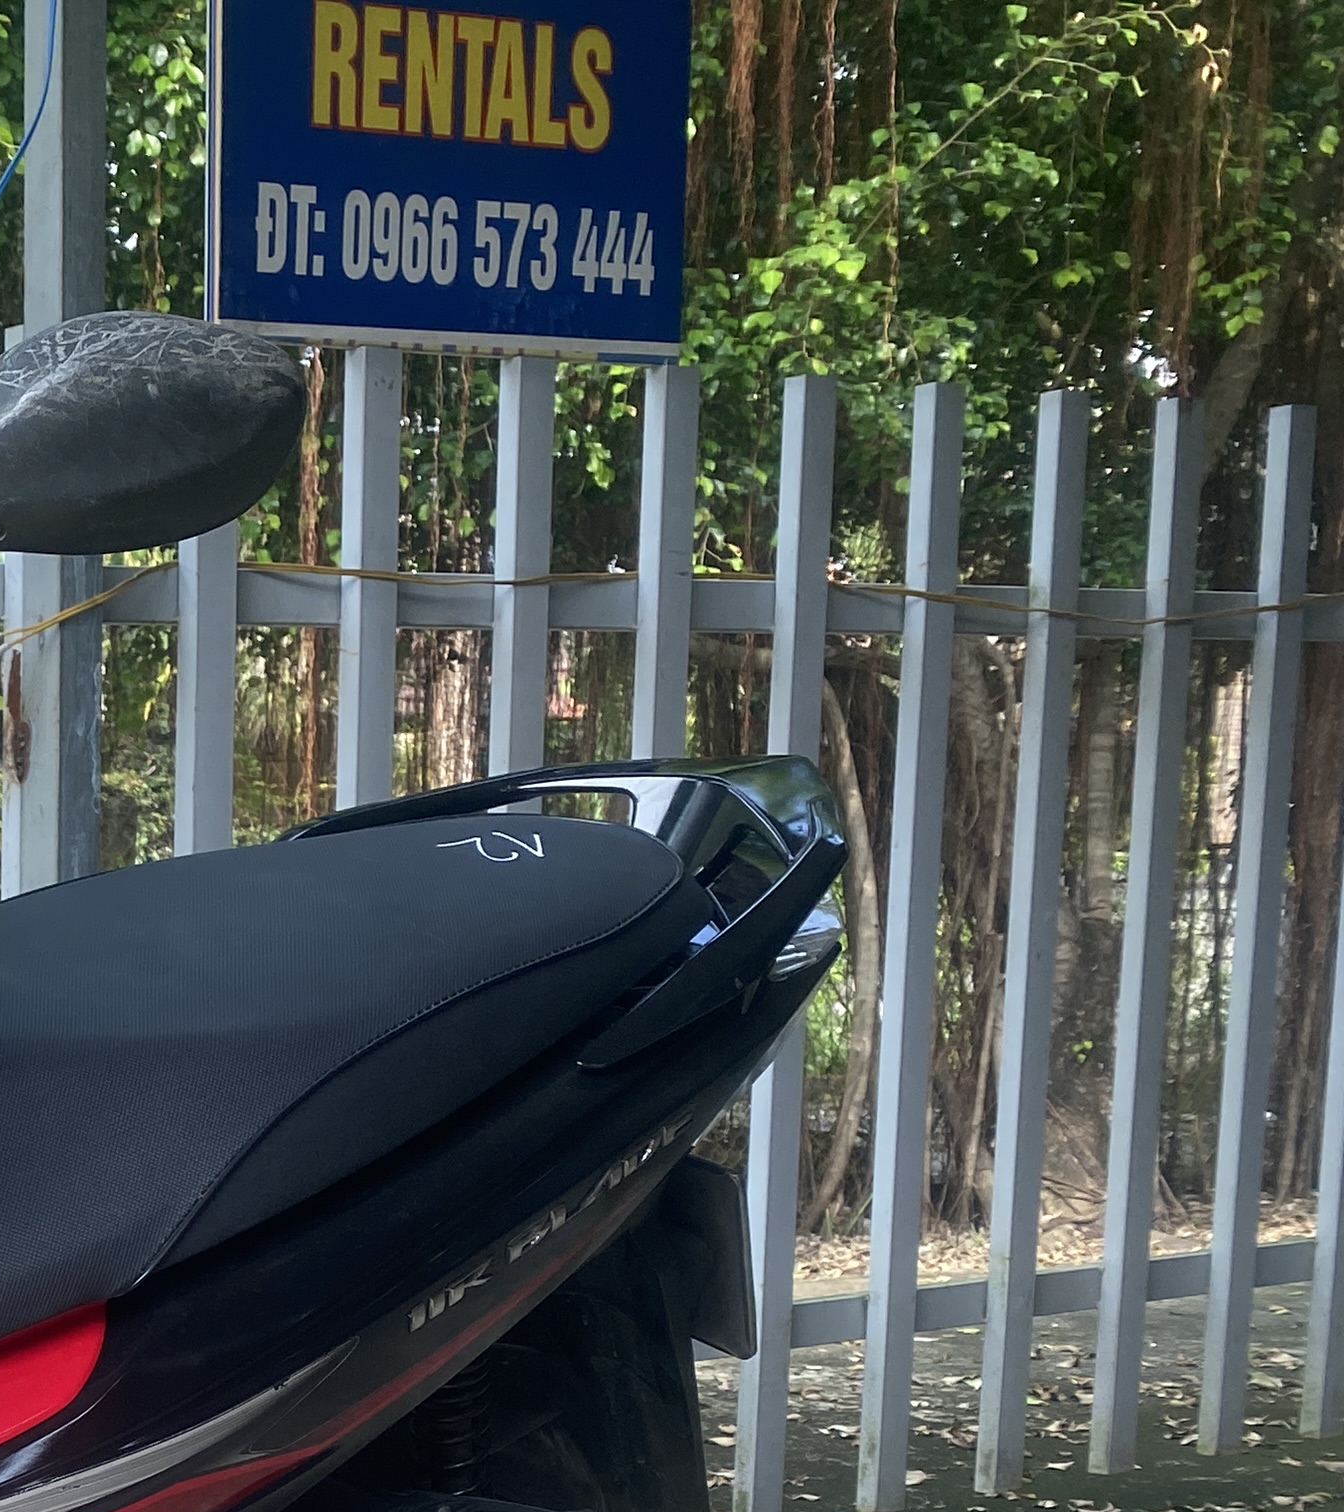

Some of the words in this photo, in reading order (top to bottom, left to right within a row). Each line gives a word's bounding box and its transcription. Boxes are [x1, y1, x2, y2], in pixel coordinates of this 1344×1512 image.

[311, 0, 613, 152] RENTALS
[255, 181, 326, 276] ĐT:
[342, 189, 458, 285] 0966
[473, 200, 558, 291] 573
[572, 207, 655, 296] 444
